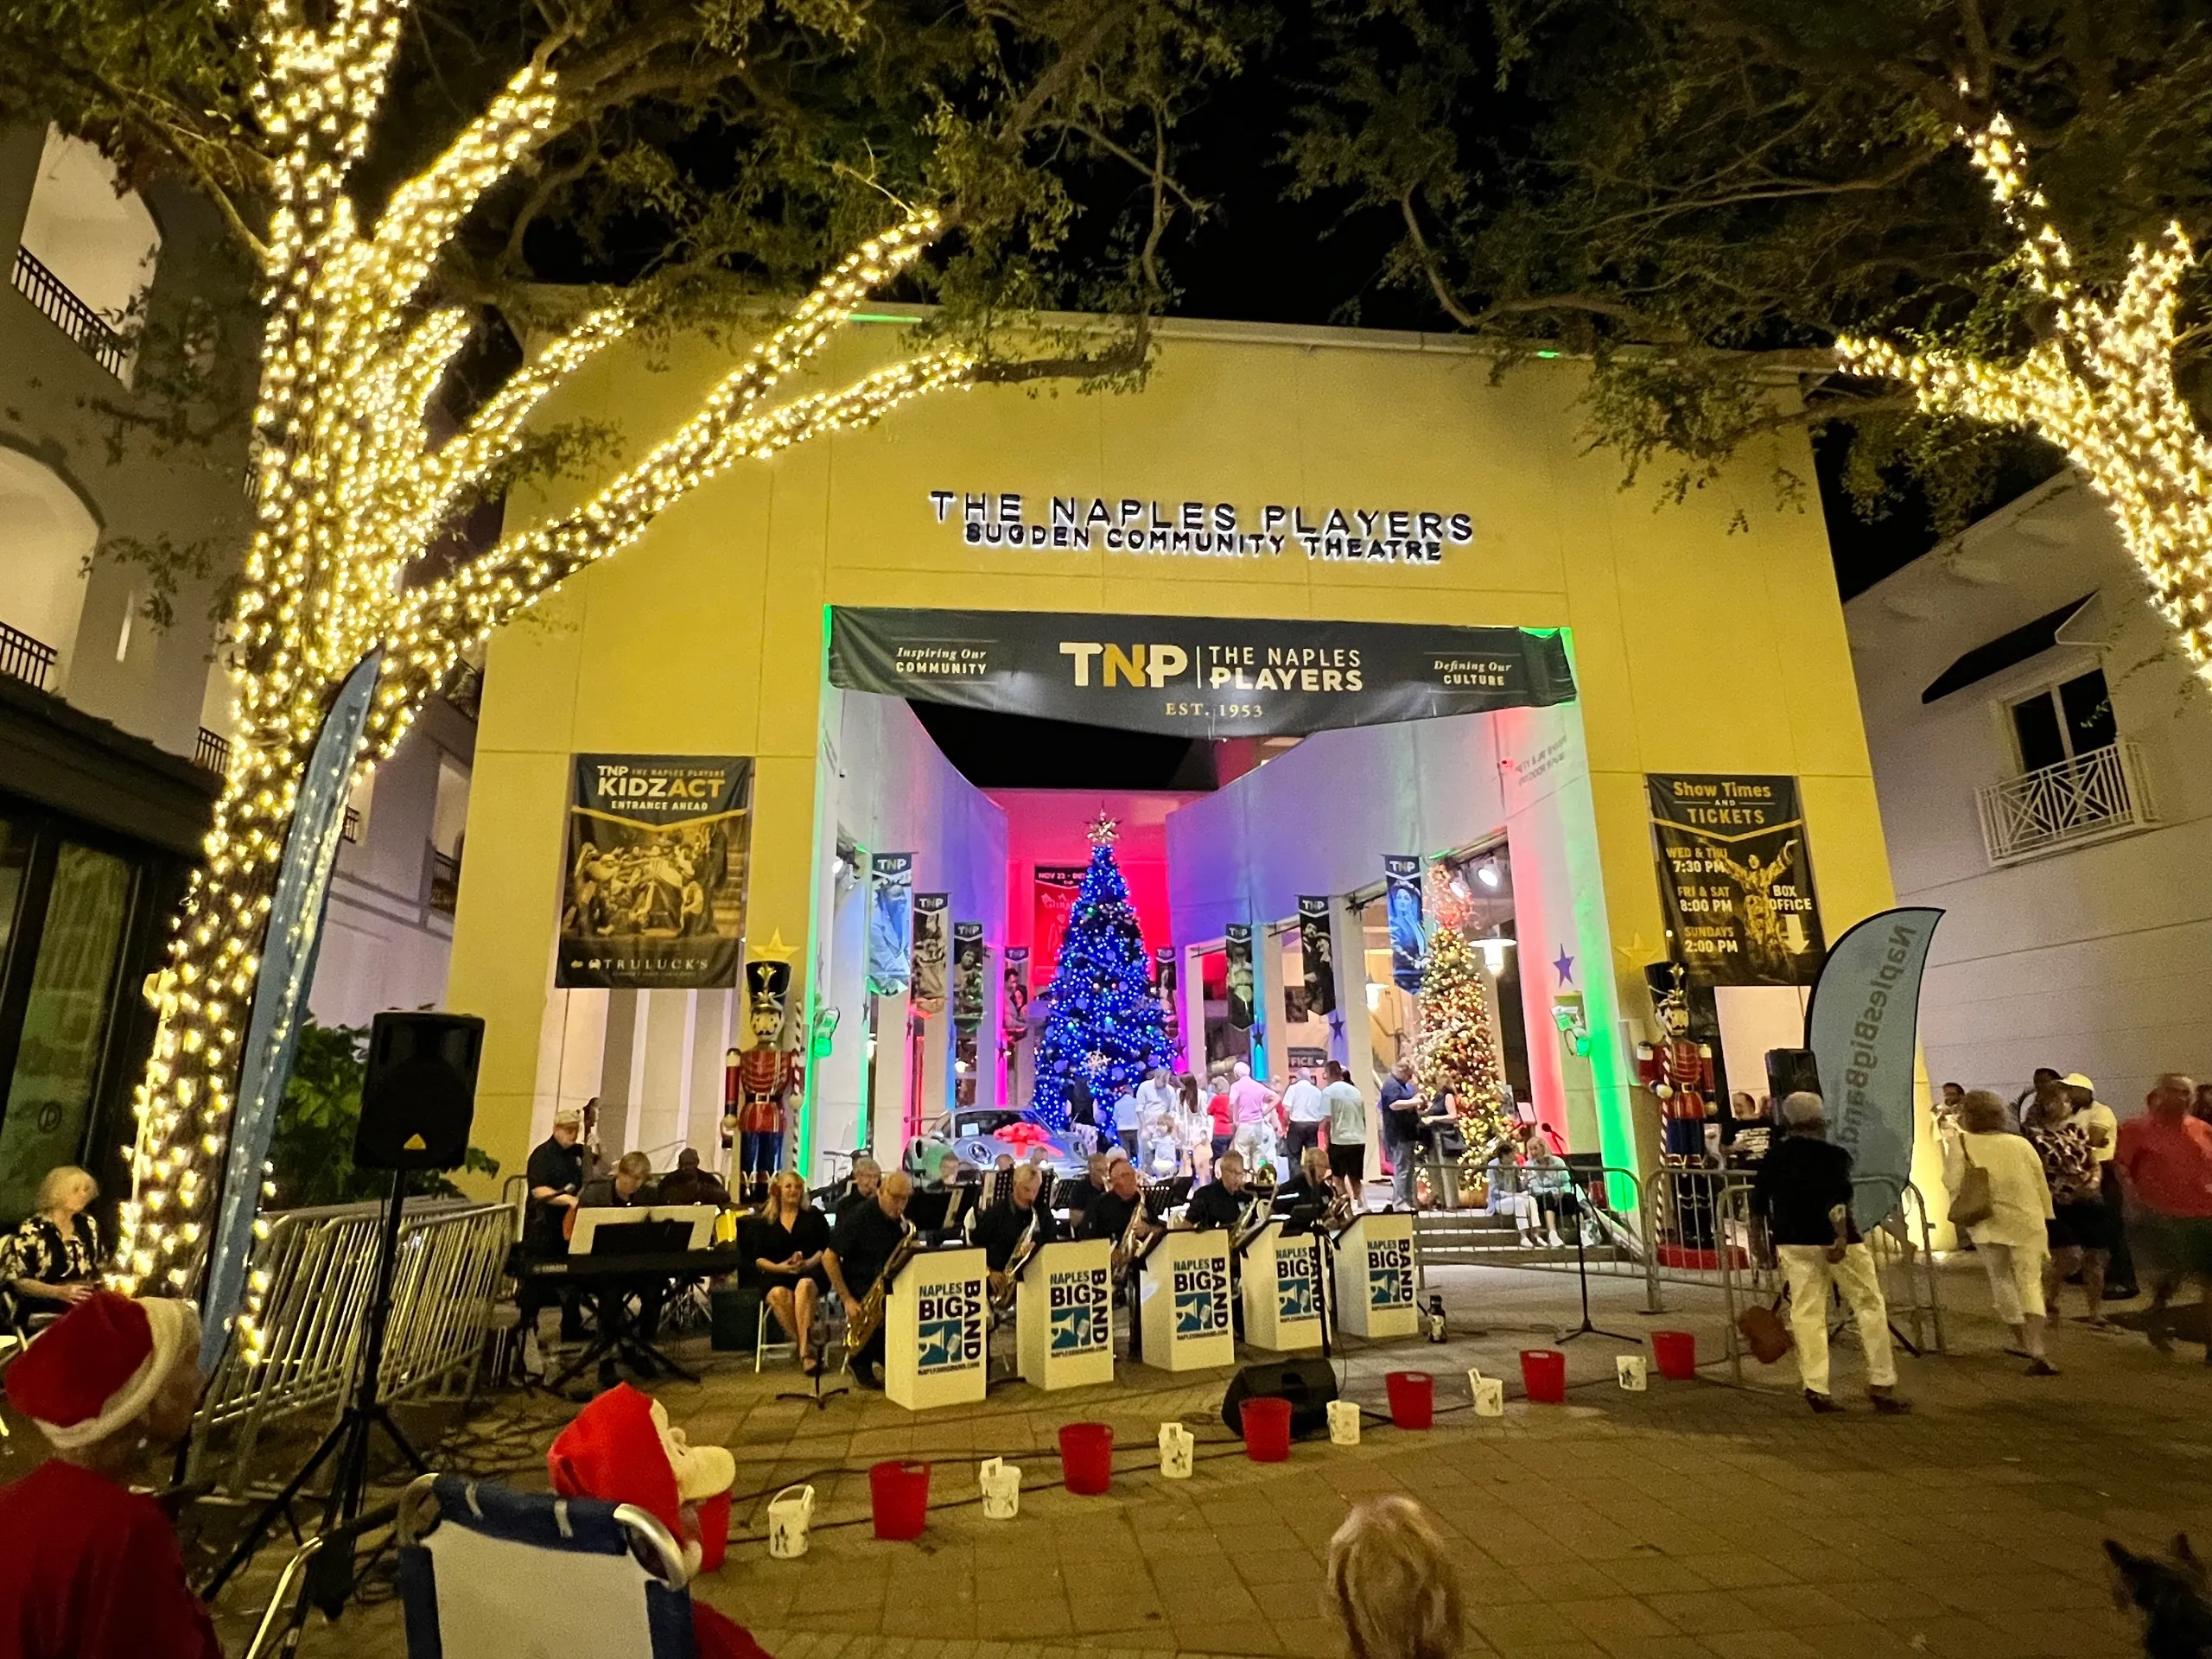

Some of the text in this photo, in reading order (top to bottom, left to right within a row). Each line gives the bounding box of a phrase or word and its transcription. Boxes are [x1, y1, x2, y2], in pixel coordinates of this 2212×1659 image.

[931, 491, 1472, 541] THE NAPLES PLAYERS
[1107, 529, 1285, 556] COMMUNITY
[1305, 537, 1441, 562] THEATRE
[896, 647, 987, 661] Inspiring Our
[1209, 646, 1361, 667] THE NAPLES
[896, 662, 987, 674] COMMUNITY
[1059, 643, 1188, 688] TNP
[1434, 660, 1512, 672] Defining Our
[1210, 667, 1363, 691] PLAYERS
[1443, 674, 1504, 686] CULTURE
[1166, 703, 1263, 718] EST. 1953
[597, 766, 629, 777] TNP
[598, 777, 726, 798] KIDZACT
[1673, 781, 1771, 798] Show Times
[611, 800, 709, 811] ENTRANCE AHEAD
[1688, 808, 1764, 824] TICKETS
[1666, 847, 1728, 859] WED & THU
[877, 858, 907, 870] TNP
[1389, 860, 1415, 872] TNP
[1672, 861, 1727, 874] 7:30 PM
[1677, 887, 1730, 898] FRI & SAT
[1772, 885, 1797, 897] BOX
[918, 897, 944, 907] TNP
[1302, 899, 1325, 910] TNP
[1680, 899, 1732, 912] 8:00 PM
[1770, 898, 1812, 911] OFFICE
[957, 925, 979, 935] TNP
[1684, 926, 1734, 938] SUNDAYS
[1685, 939, 1738, 953] 2:00 PM
[604, 958, 709, 970] TRULUCK'S
[1367, 1239, 1397, 1250] NAPLES
[1276, 1247, 1307, 1259] NAPLES
[1368, 1250, 1399, 1268] BIG
[1173, 1258, 1210, 1271] NAPLES
[1277, 1259, 1309, 1279] BIG
[1398, 1238, 1414, 1302] BAND
[1050, 1270, 1090, 1285] NAPLES
[1174, 1271, 1211, 1293] BIG
[919, 1281, 963, 1297] NAPLES
[1051, 1284, 1090, 1307] BIG
[1211, 1257, 1229, 1328] BAND
[919, 1296, 963, 1321] BIG
[1091, 1268, 1108, 1344] BAND
[964, 1280, 982, 1360] BAND
